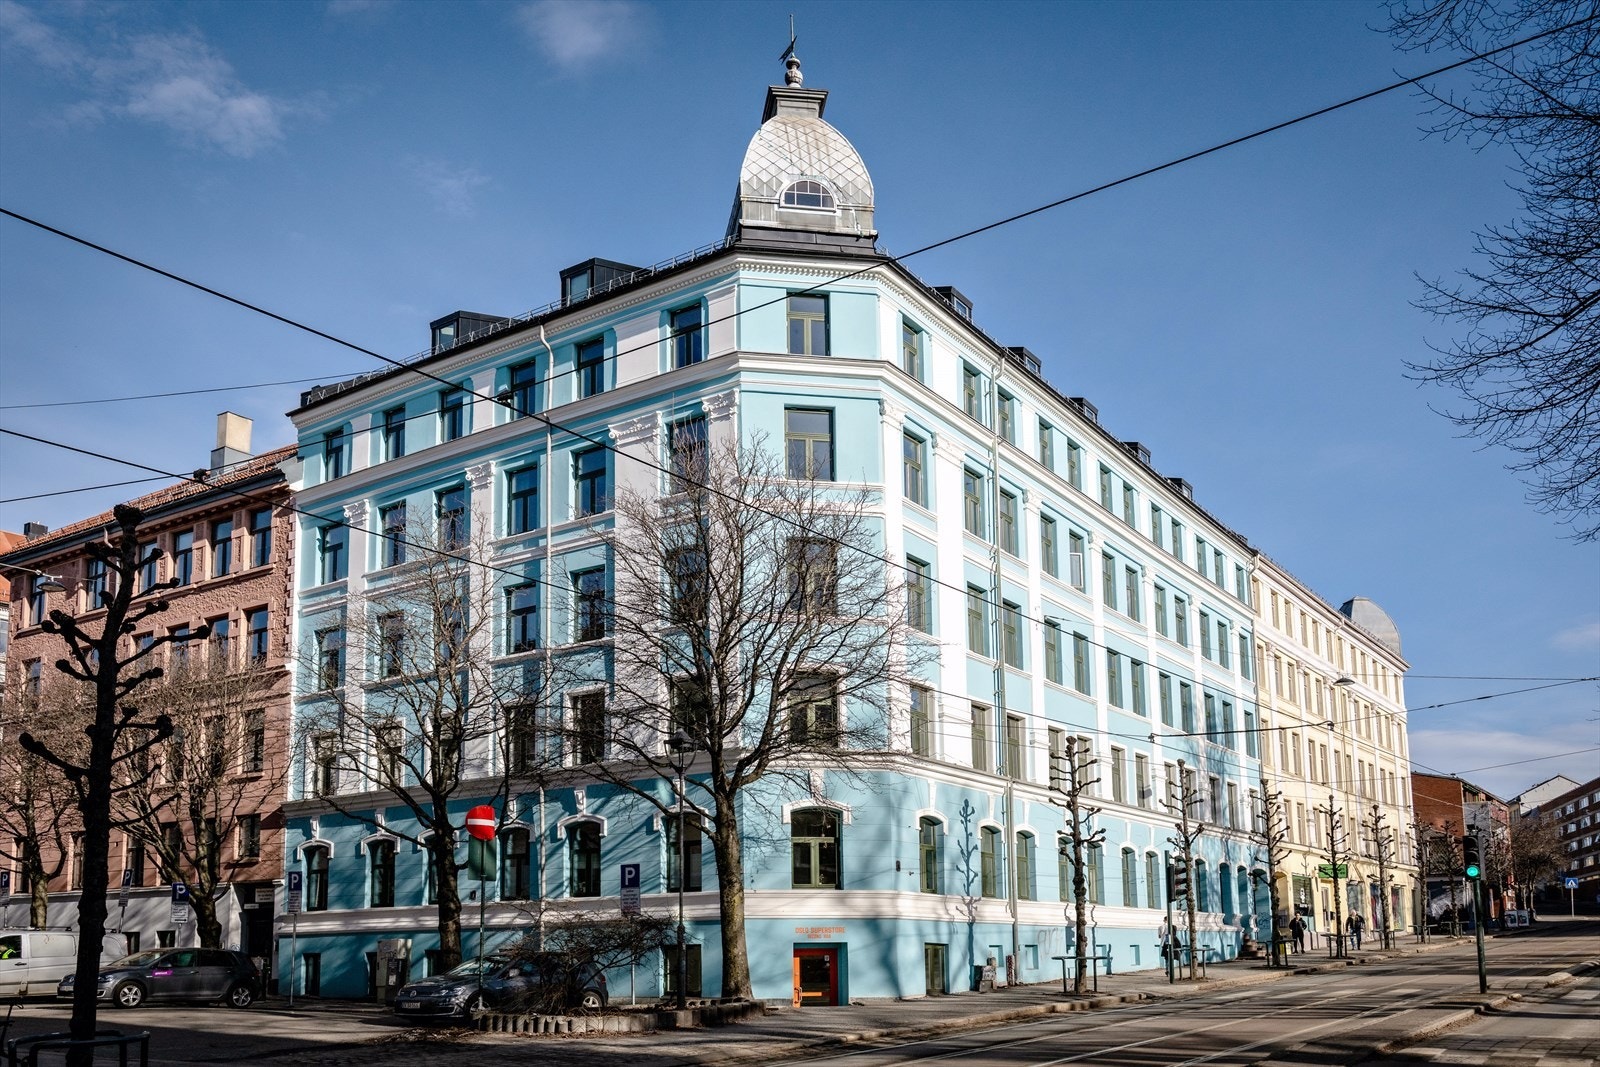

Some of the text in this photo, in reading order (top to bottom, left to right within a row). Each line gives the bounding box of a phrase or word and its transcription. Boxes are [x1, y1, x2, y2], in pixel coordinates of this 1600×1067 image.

[2, 873, 9, 887] P
[123, 871, 131, 885] P
[291, 873, 299, 889] P
[625, 867, 636, 886] P
[176, 884, 187, 900] P
